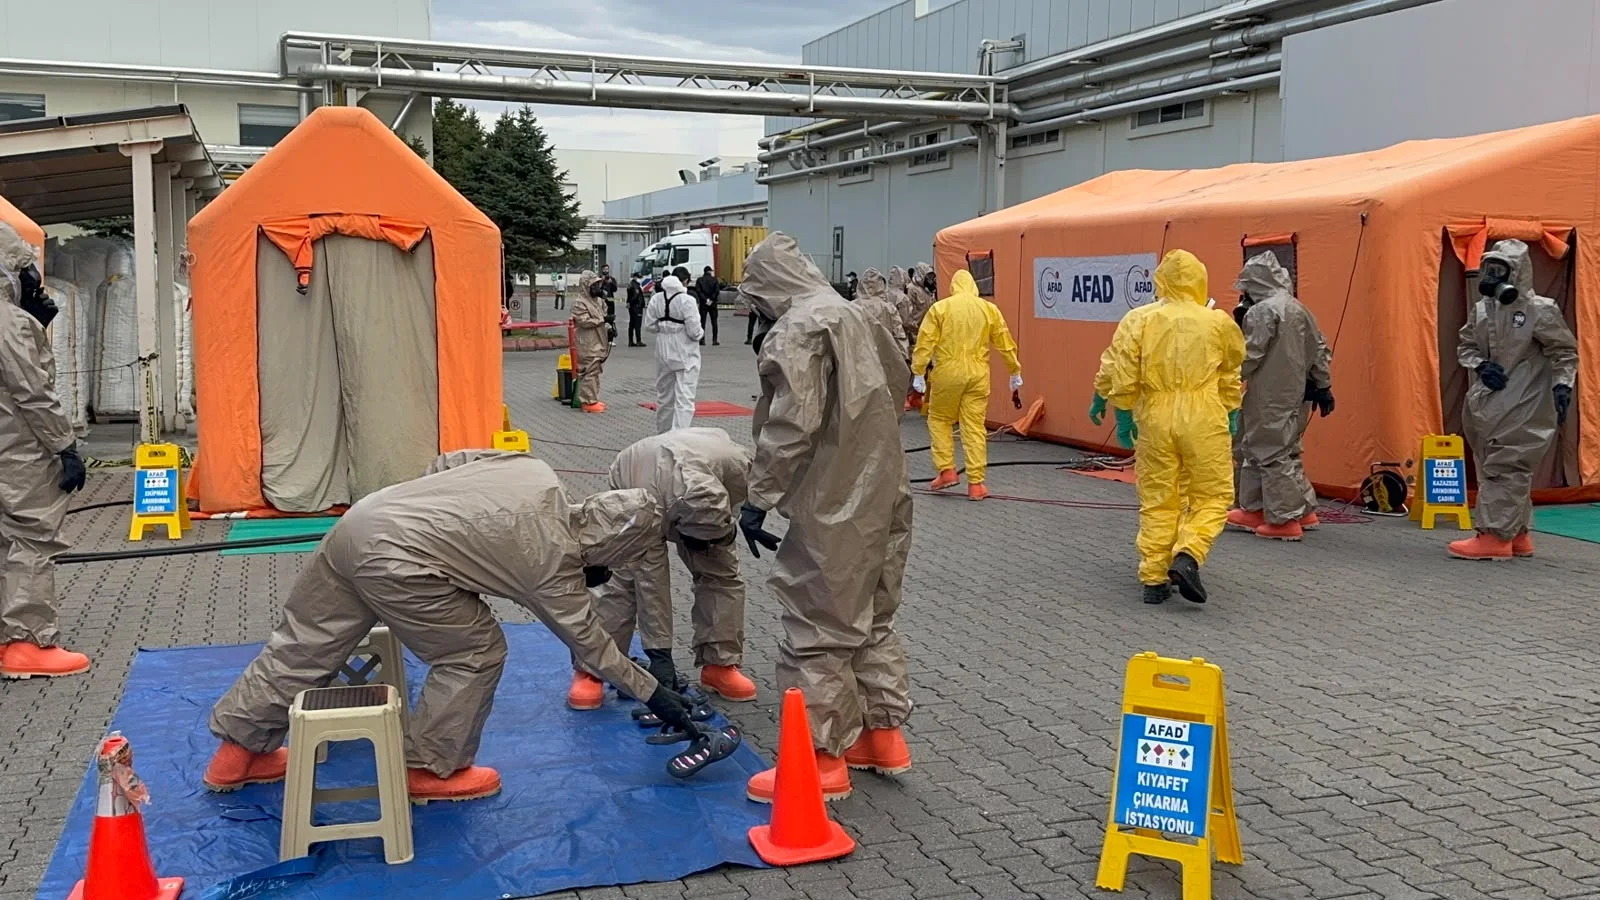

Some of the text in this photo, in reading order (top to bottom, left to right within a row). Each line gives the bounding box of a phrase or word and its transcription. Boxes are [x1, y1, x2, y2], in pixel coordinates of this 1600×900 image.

[1047, 282, 1063, 293] AFAD
[1071, 275, 1114, 303] AFAD
[1134, 281, 1153, 293] AFAD
[1148, 723, 1184, 739] AFAD
[1137, 771, 1189, 792] KIYAFET
[1133, 791, 1189, 814] ÇIKARMA
[1125, 807, 1195, 835] İSTASYONU
